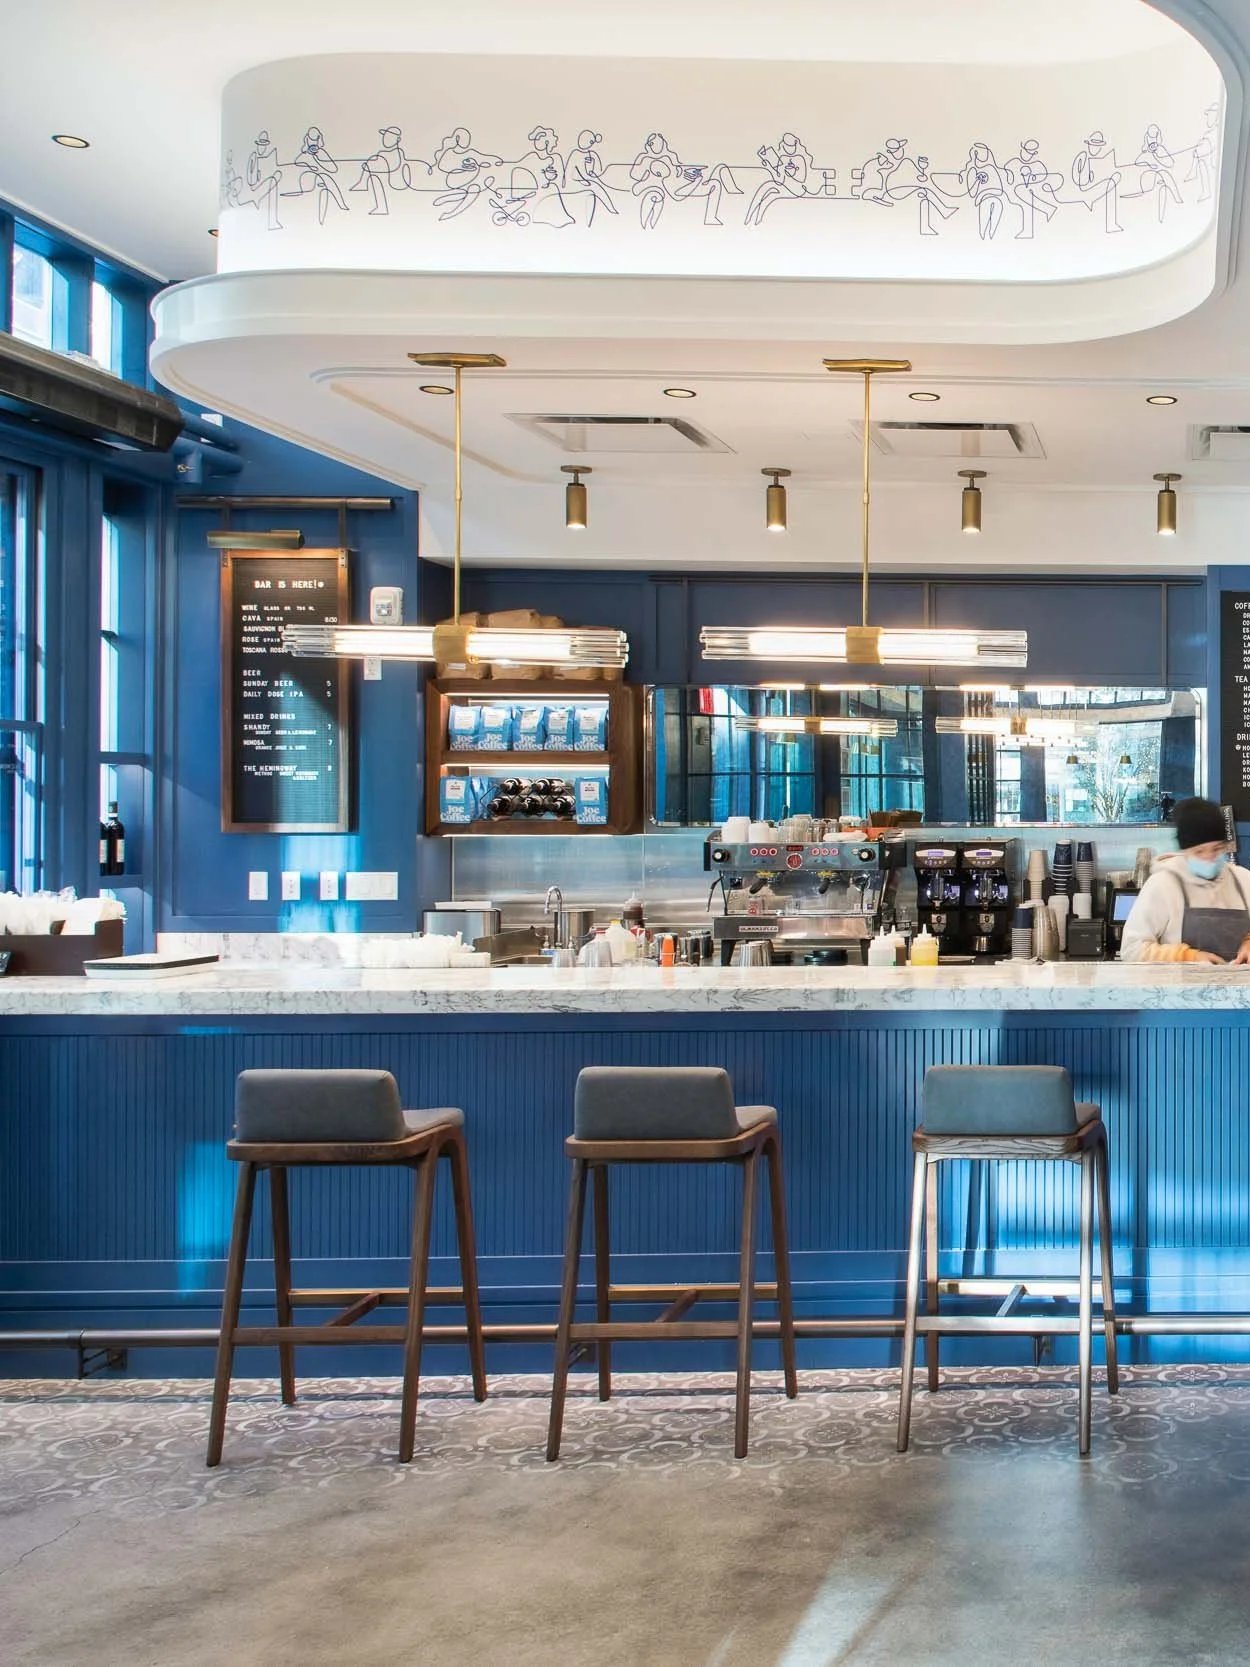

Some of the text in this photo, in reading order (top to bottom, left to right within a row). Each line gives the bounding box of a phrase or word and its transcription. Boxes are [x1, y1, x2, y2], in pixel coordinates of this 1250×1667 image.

[254, 580, 317, 589] BAR IS HERE!
[478, 741, 508, 750] Coffee
[513, 742, 543, 751] Coffee
[544, 742, 573, 751] Coffee
[574, 742, 605, 751] Coffee
[440, 812, 471, 822] Coffee
[576, 815, 606, 824] Coffee
